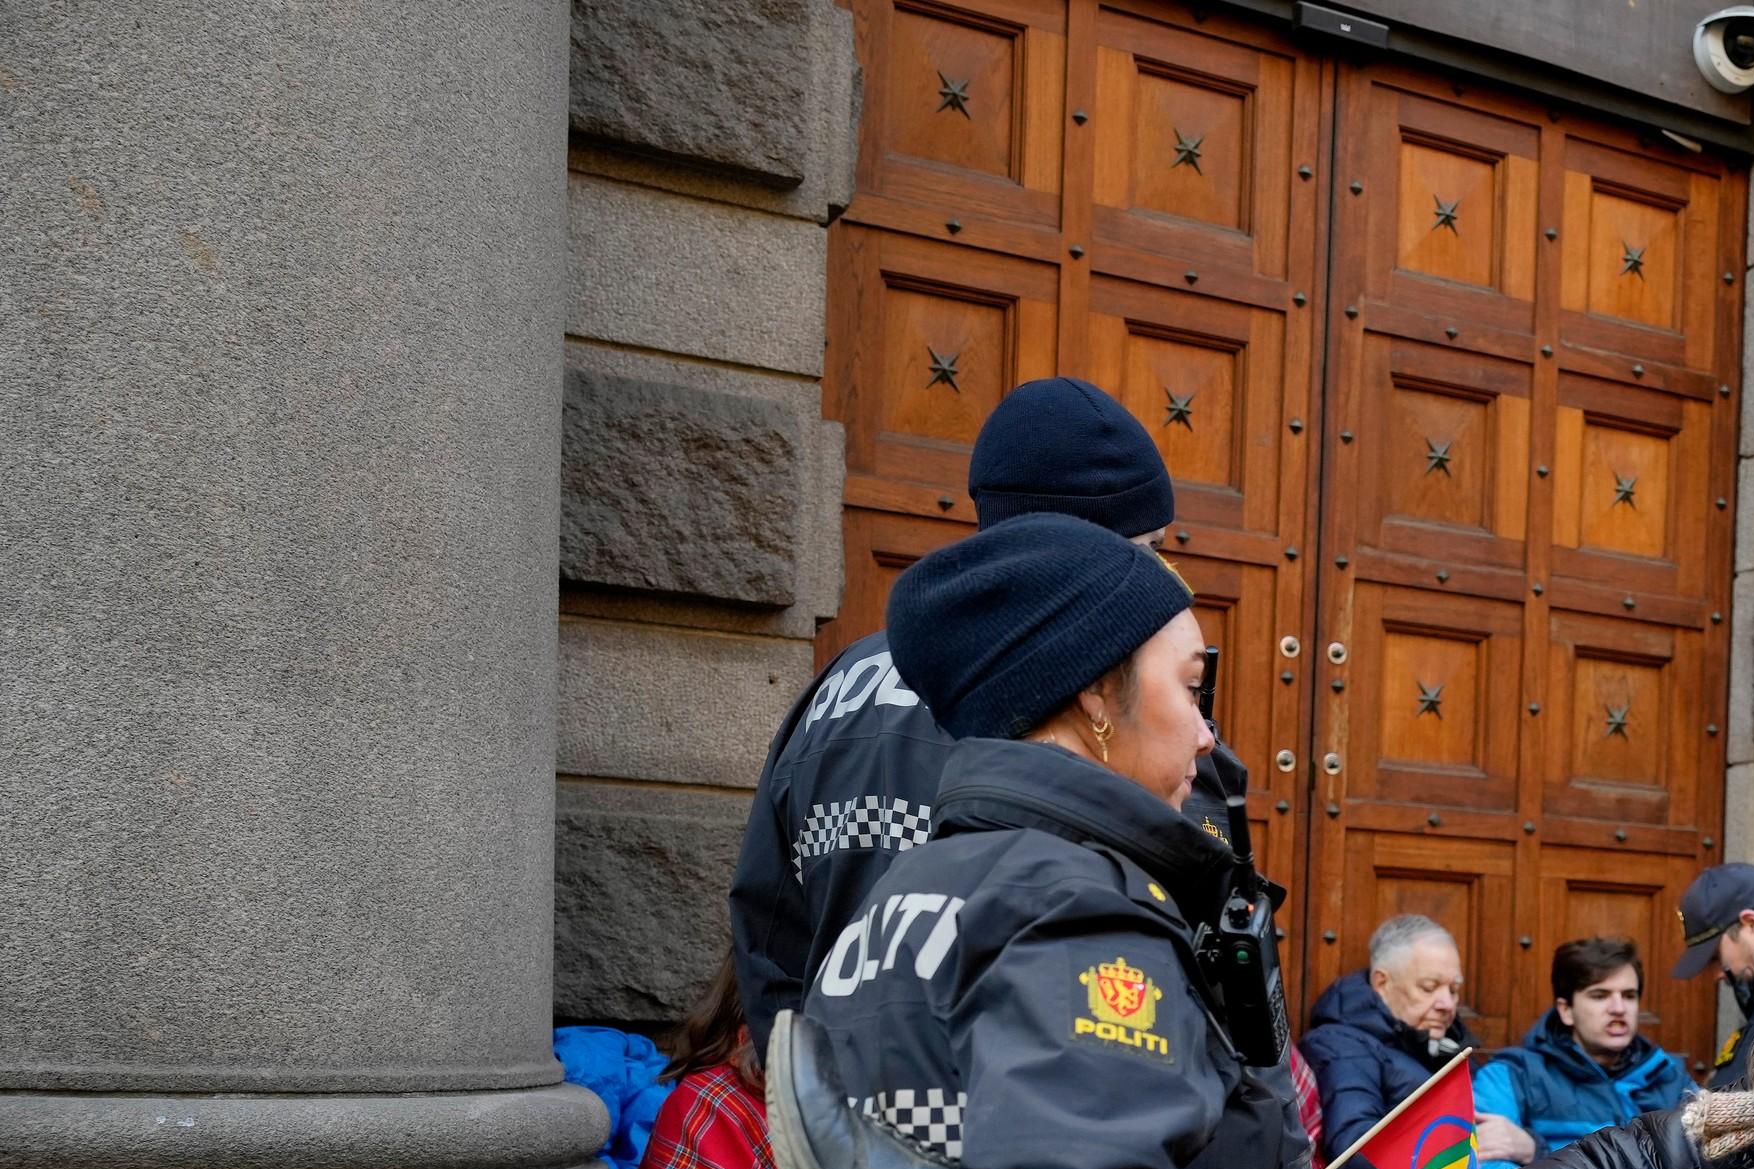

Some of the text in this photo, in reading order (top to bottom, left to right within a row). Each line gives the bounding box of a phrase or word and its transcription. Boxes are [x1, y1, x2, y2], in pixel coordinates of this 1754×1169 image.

[805, 651, 929, 734] POL
[814, 893, 966, 997] OLITI
[1074, 1017, 1168, 1055] POLITI
